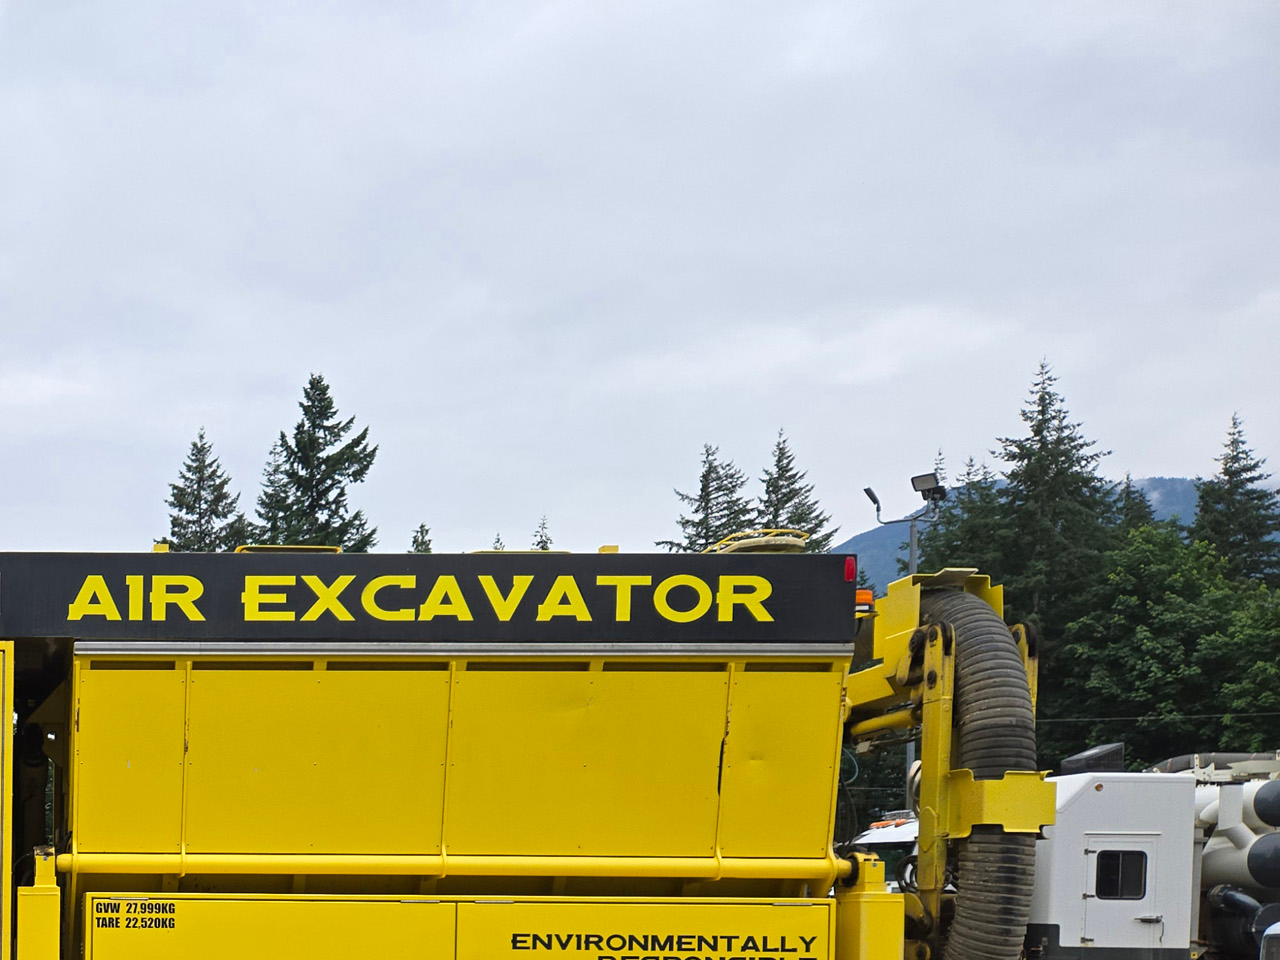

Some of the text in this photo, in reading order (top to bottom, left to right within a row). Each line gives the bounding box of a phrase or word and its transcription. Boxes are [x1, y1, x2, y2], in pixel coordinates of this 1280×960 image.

[67, 574, 775, 623] AIR EXCAVATOR
[95, 902, 176, 915] GVW 27,999KG
[95, 917, 176, 929] TARE 22,520KG
[511, 933, 818, 953] ENVIRONMENTALLY
